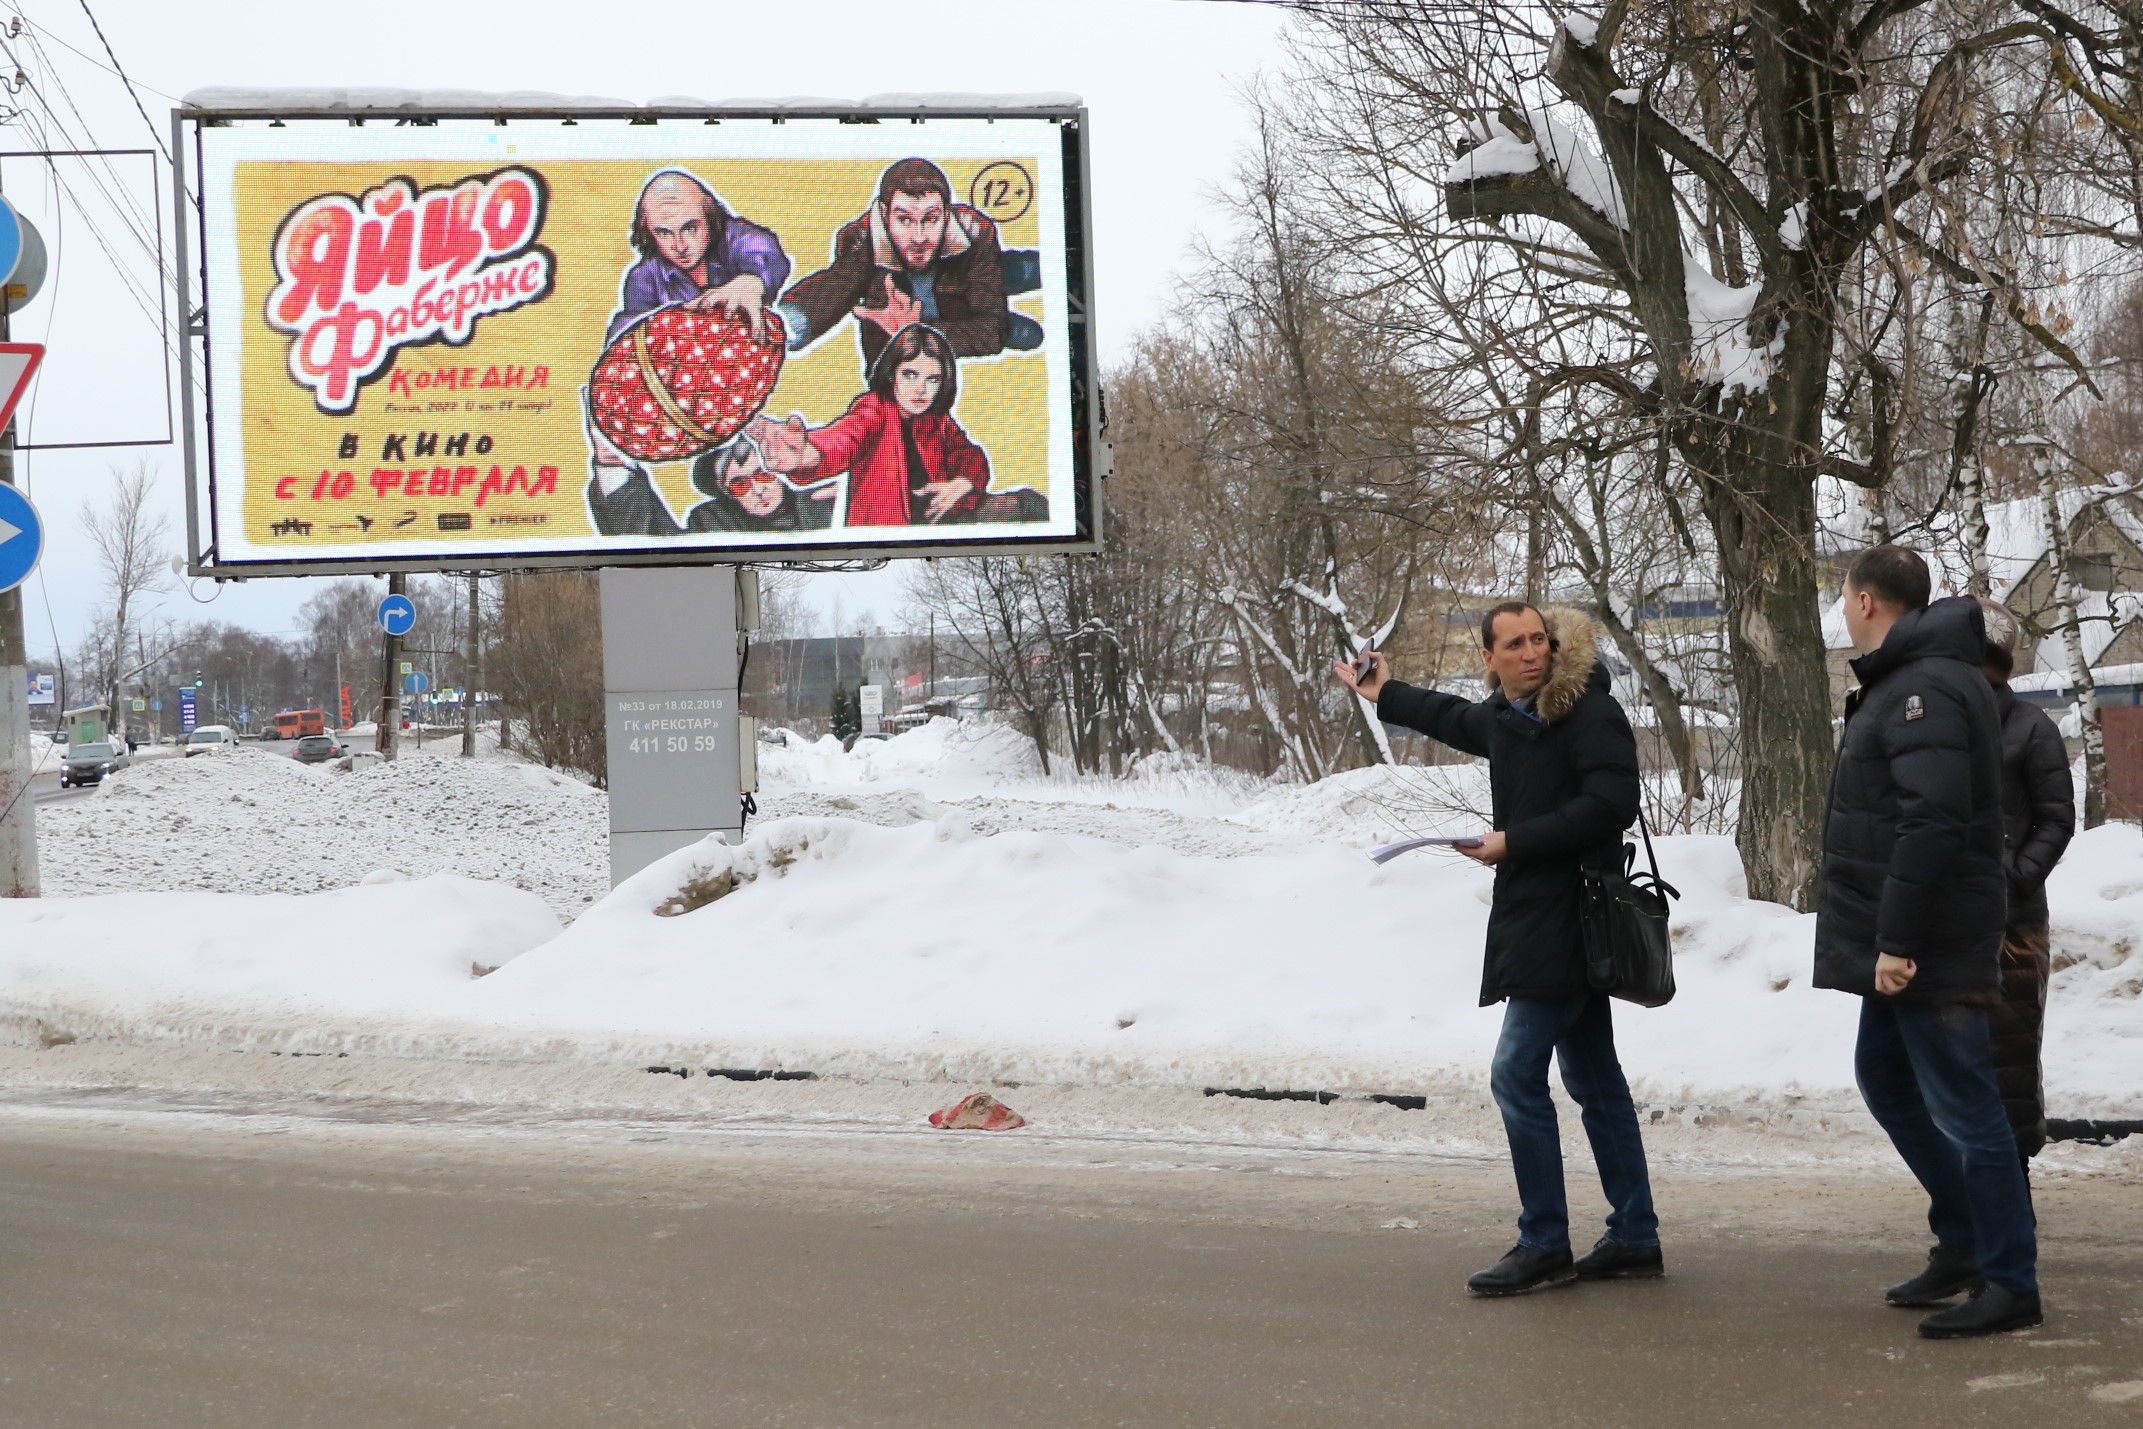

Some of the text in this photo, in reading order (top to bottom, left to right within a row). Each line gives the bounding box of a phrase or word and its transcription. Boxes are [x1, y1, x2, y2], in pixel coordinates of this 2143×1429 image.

[984, 179, 1025, 208] 12+
[338, 431, 494, 461] В КИНО
[312, 470, 356, 500] 10
[370, 464, 560, 507] ФЕВРАЛЯ
[619, 700, 723, 712] №33 от 18.02.2019
[624, 718, 719, 731] ГК «РЕКСТАР»
[629, 736, 715, 753] 411 50 59
